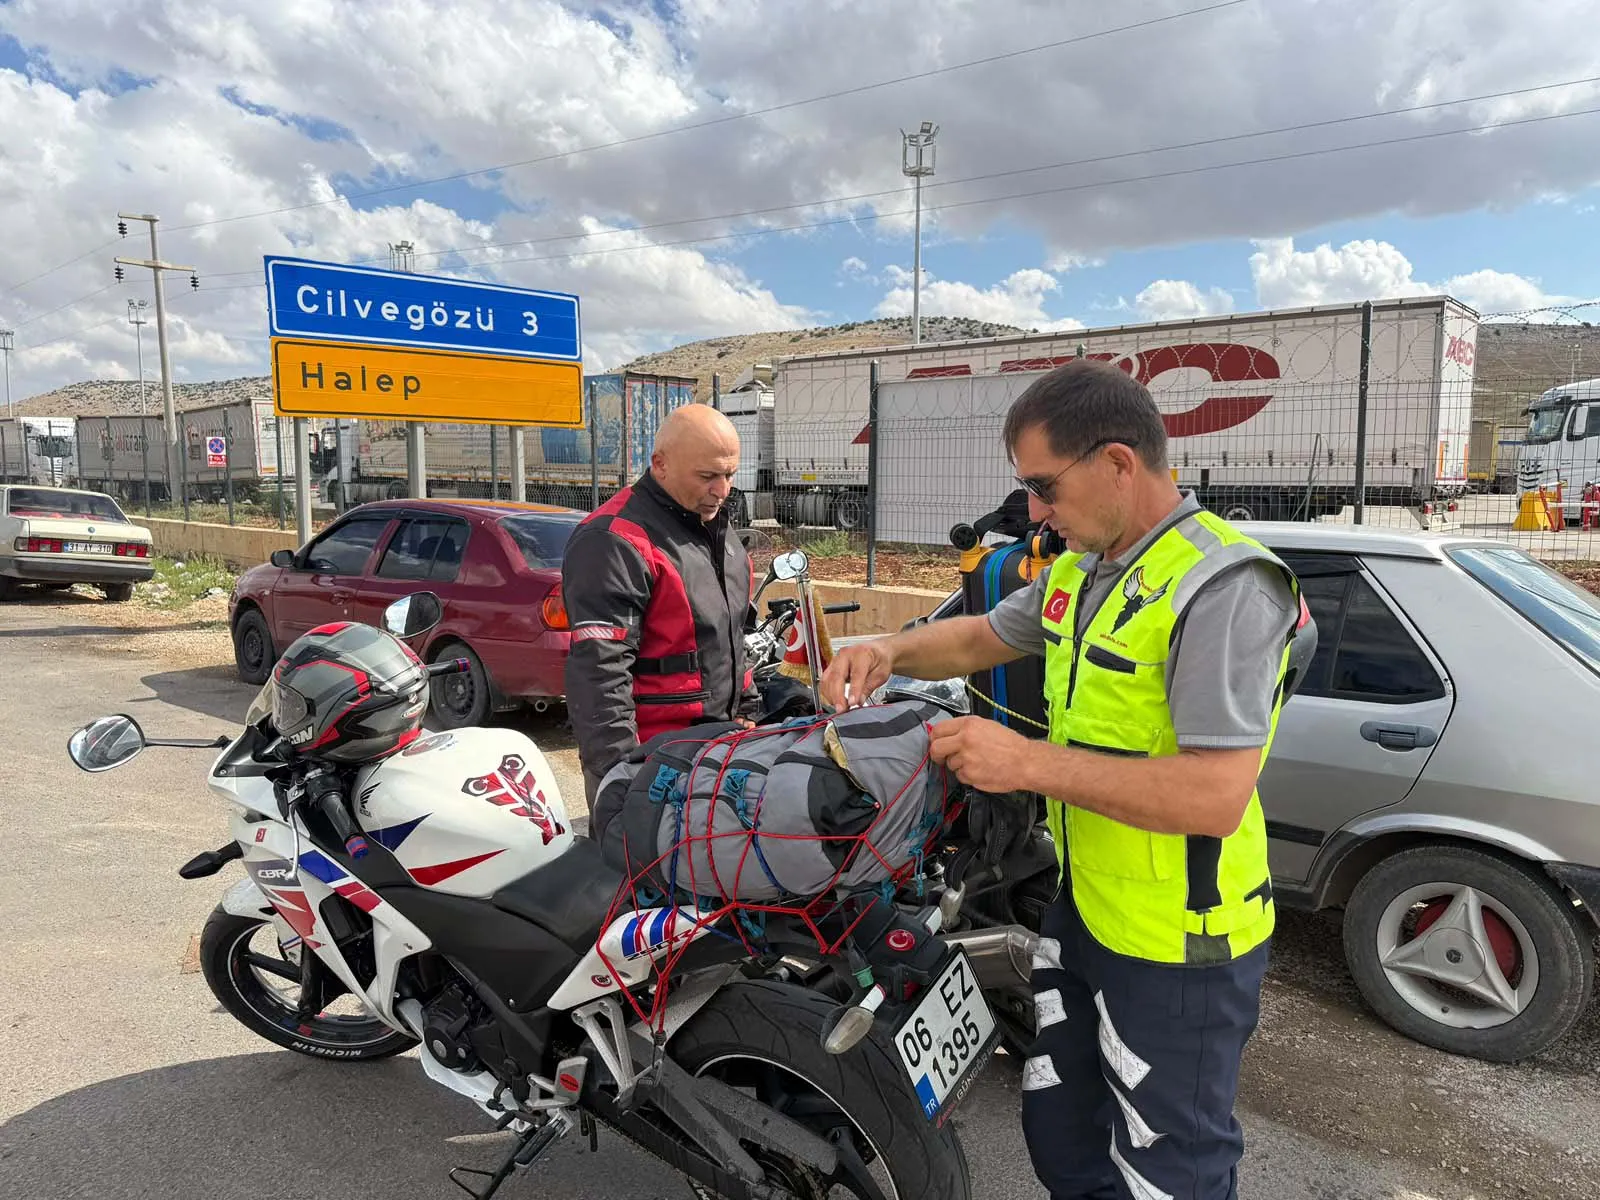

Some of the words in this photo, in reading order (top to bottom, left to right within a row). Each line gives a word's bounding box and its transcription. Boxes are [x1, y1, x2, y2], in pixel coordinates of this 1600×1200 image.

[296, 285, 494, 331] Cilvegözü
[522, 311, 539, 336] 3
[301, 362, 421, 400] Halep
[902, 1016, 932, 1068] 06
[939, 961, 974, 1018] EZ
[291, 1041, 362, 1056] MICHELIN
[932, 1010, 980, 1089] 1395
[925, 1098, 937, 1116] TR
